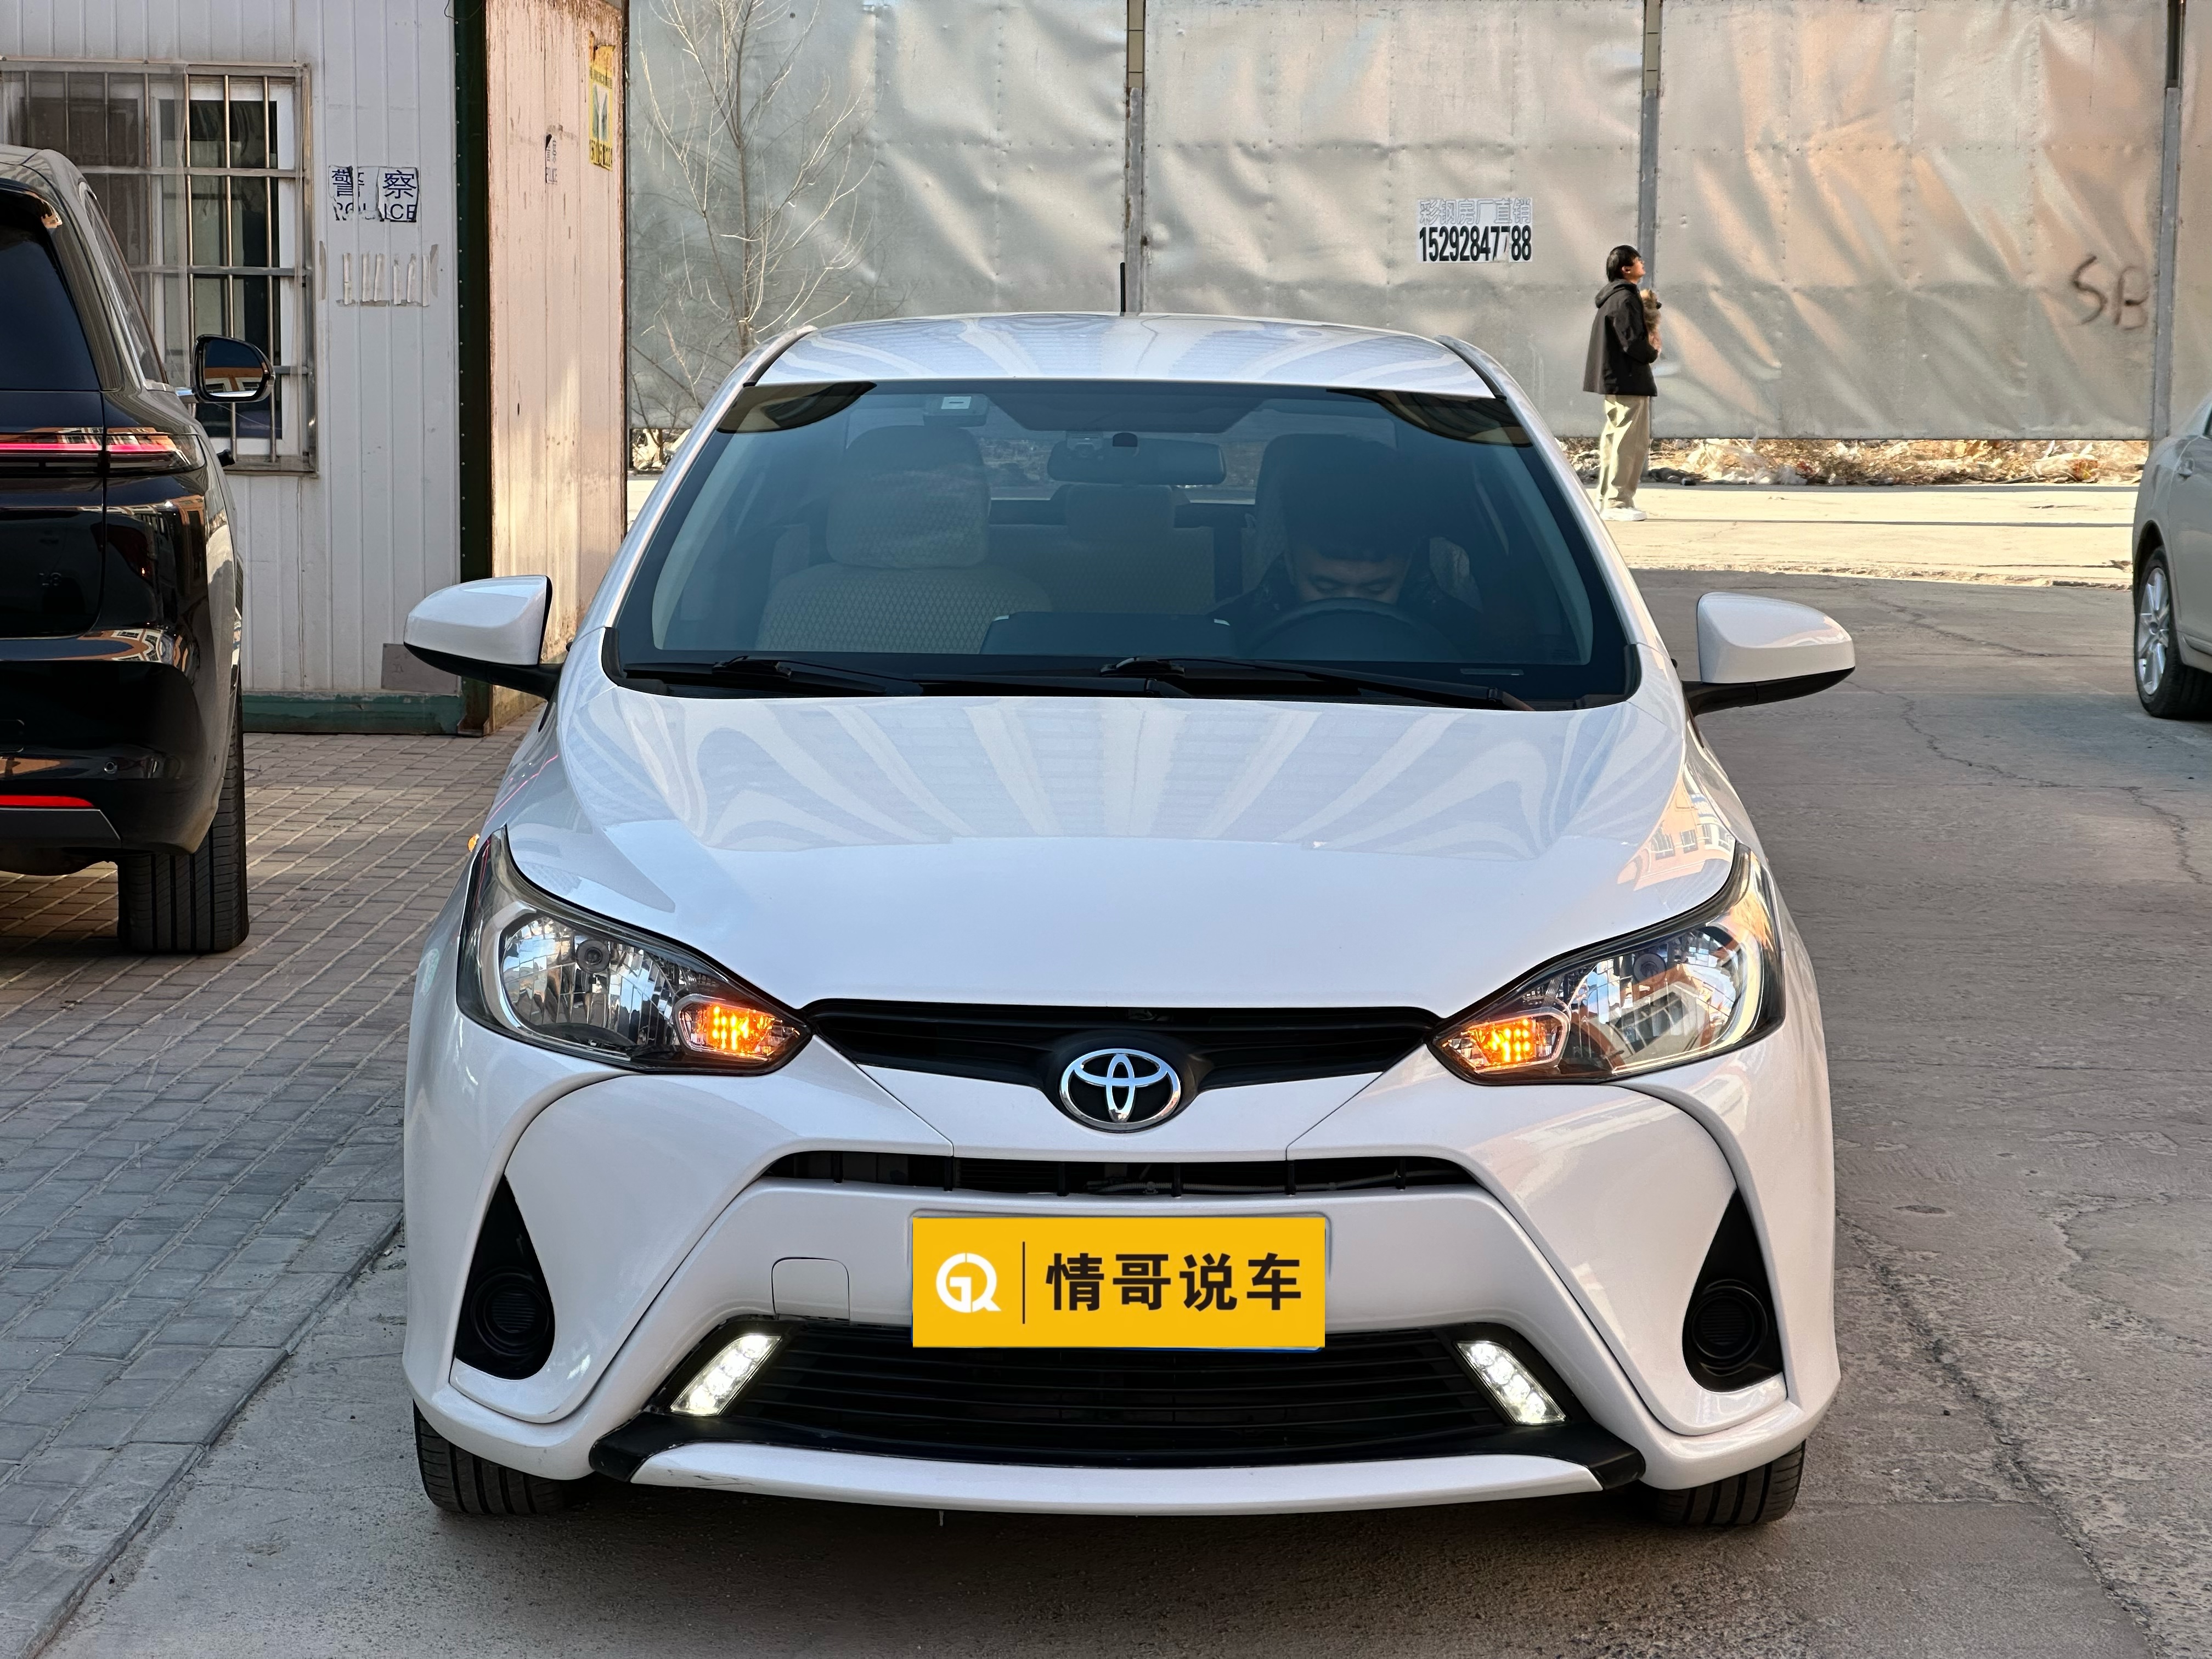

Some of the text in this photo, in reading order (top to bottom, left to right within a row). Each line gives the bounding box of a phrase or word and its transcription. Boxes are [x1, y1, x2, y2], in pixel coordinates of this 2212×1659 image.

[331, 169, 417, 199] 警察
[1419, 198, 1532, 225] 彩钢房厂直销
[1419, 225, 1532, 261] 15292847788
[2069, 255, 2150, 331] SB
